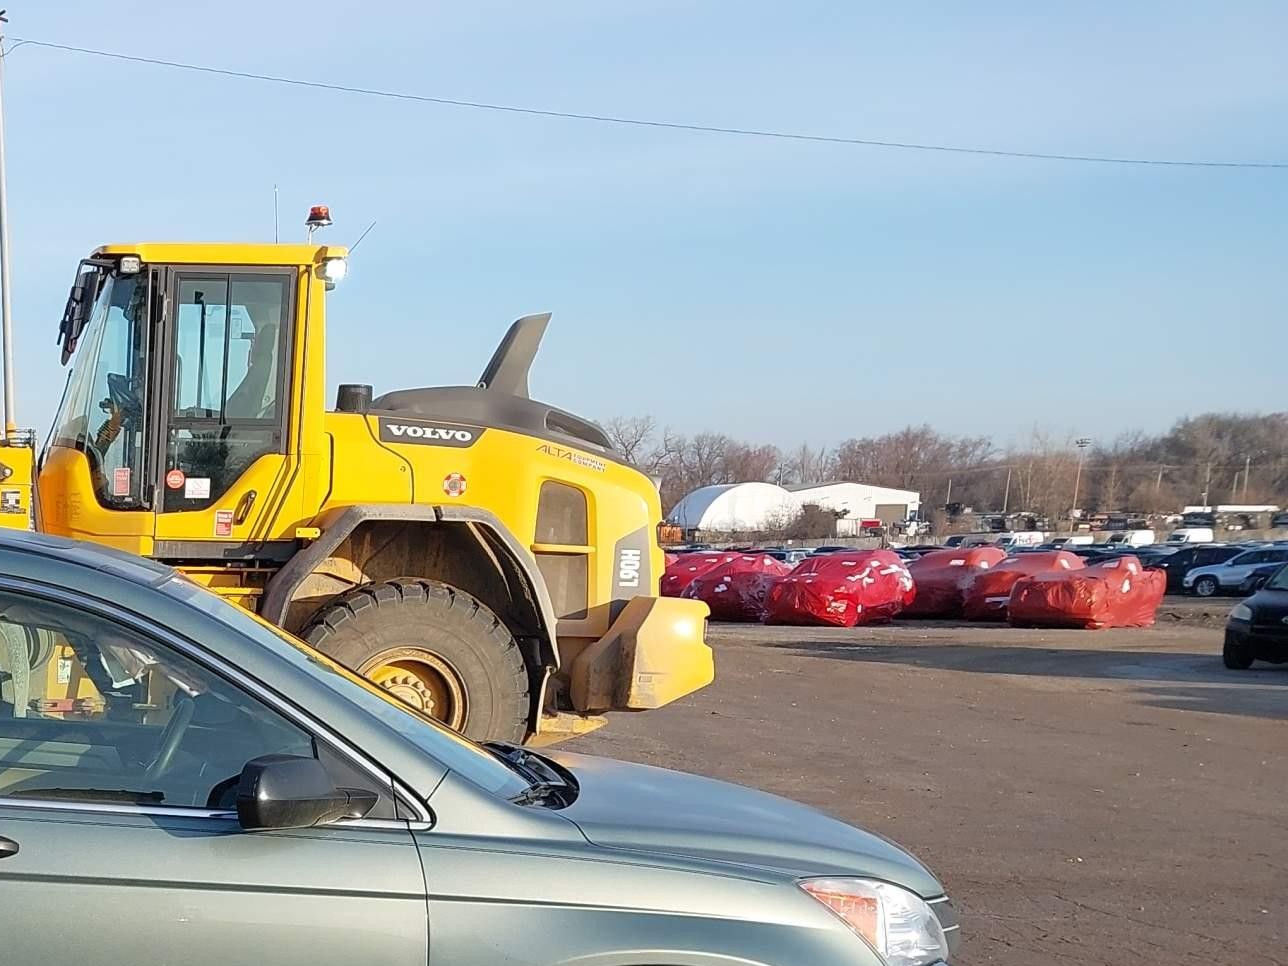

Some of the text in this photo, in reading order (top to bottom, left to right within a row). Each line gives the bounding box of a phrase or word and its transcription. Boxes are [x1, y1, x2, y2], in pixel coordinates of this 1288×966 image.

[386, 424, 472, 442] VOLVO
[536, 444, 572, 461] ALTA
[618, 549, 641, 587] L90H
